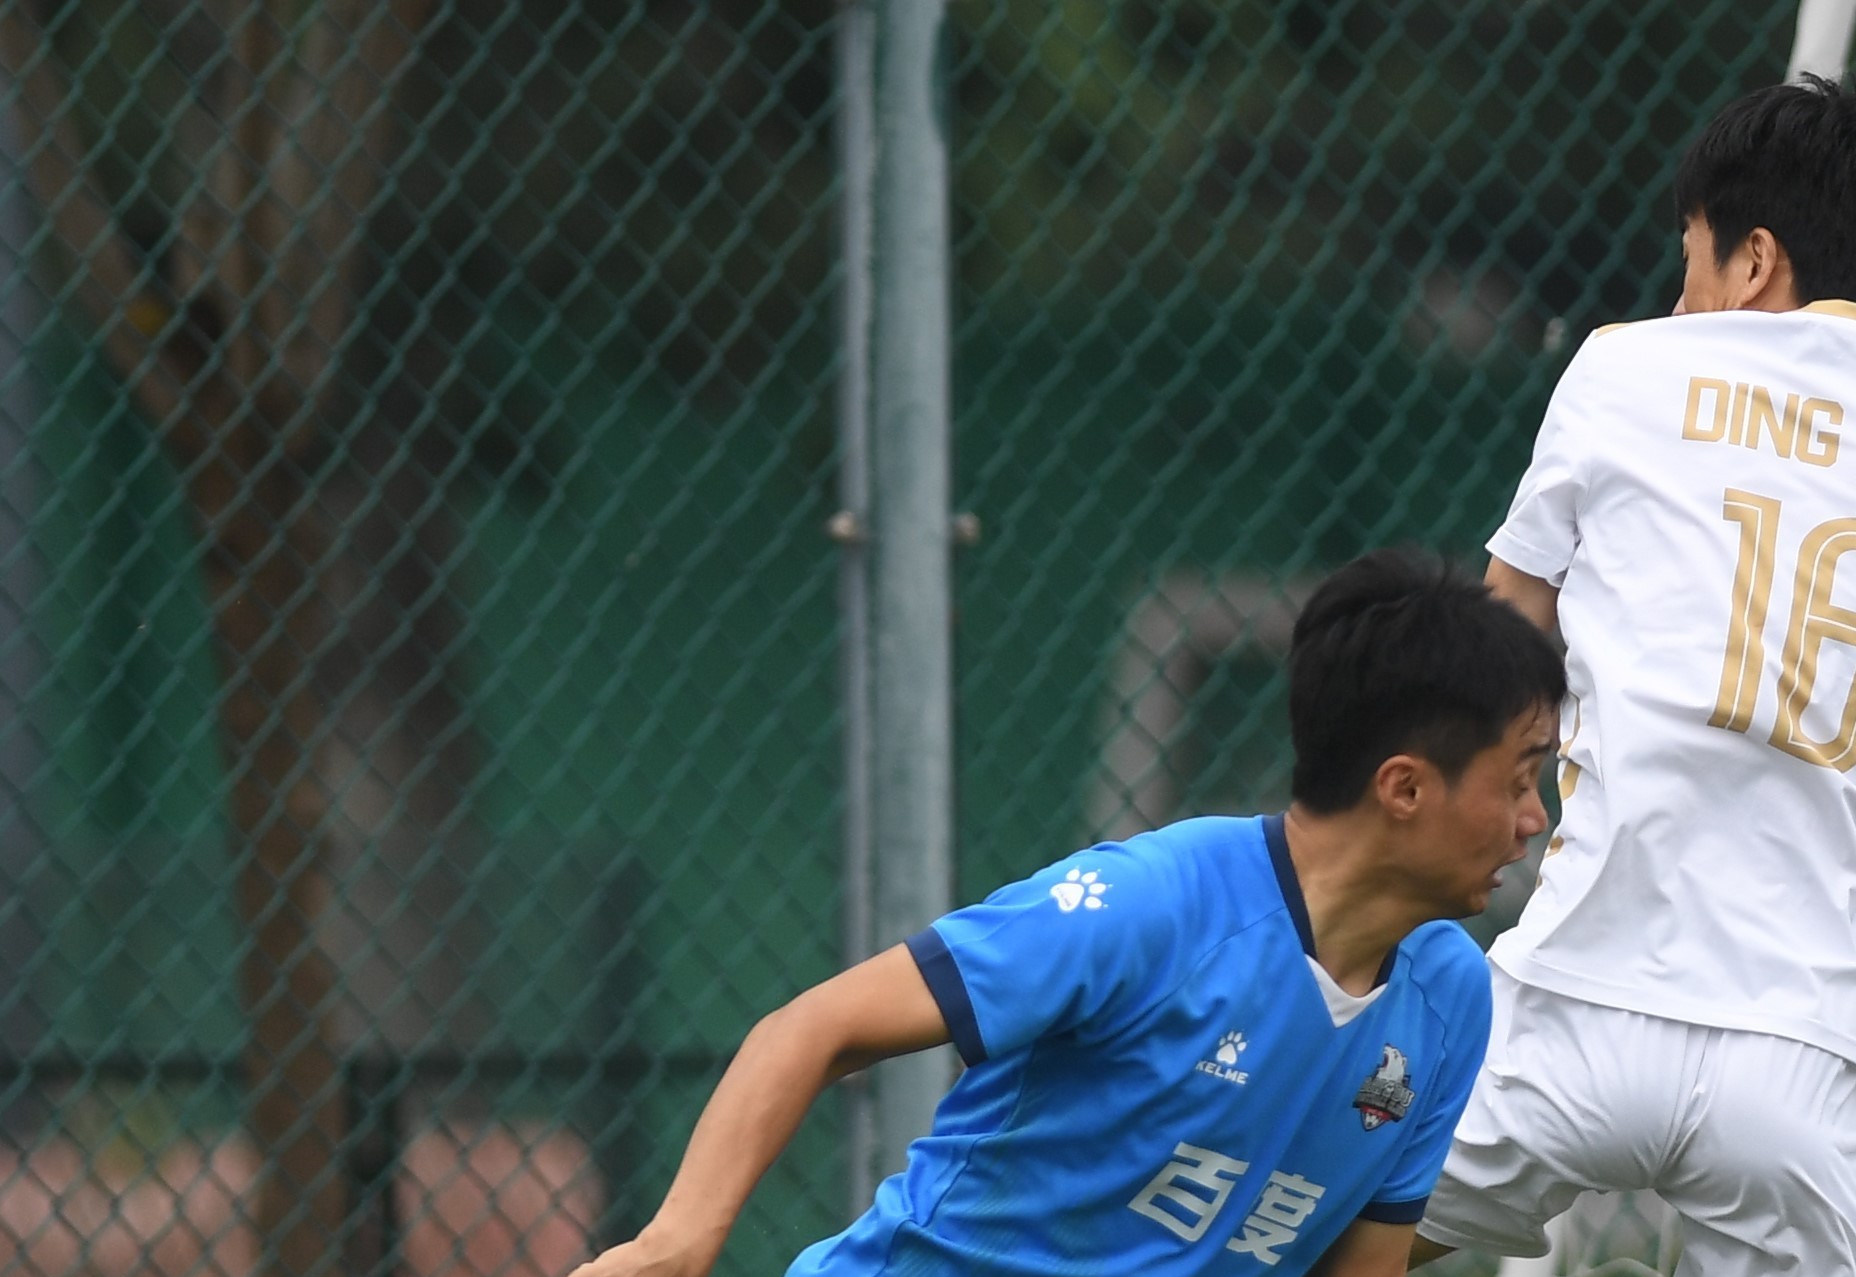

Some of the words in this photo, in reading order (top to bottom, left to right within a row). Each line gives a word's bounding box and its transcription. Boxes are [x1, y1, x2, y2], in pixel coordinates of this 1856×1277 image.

[1682, 376, 1844, 467] DING
[1195, 1060, 1249, 1085] KELME
[1128, 1141, 1326, 1265] 百度
